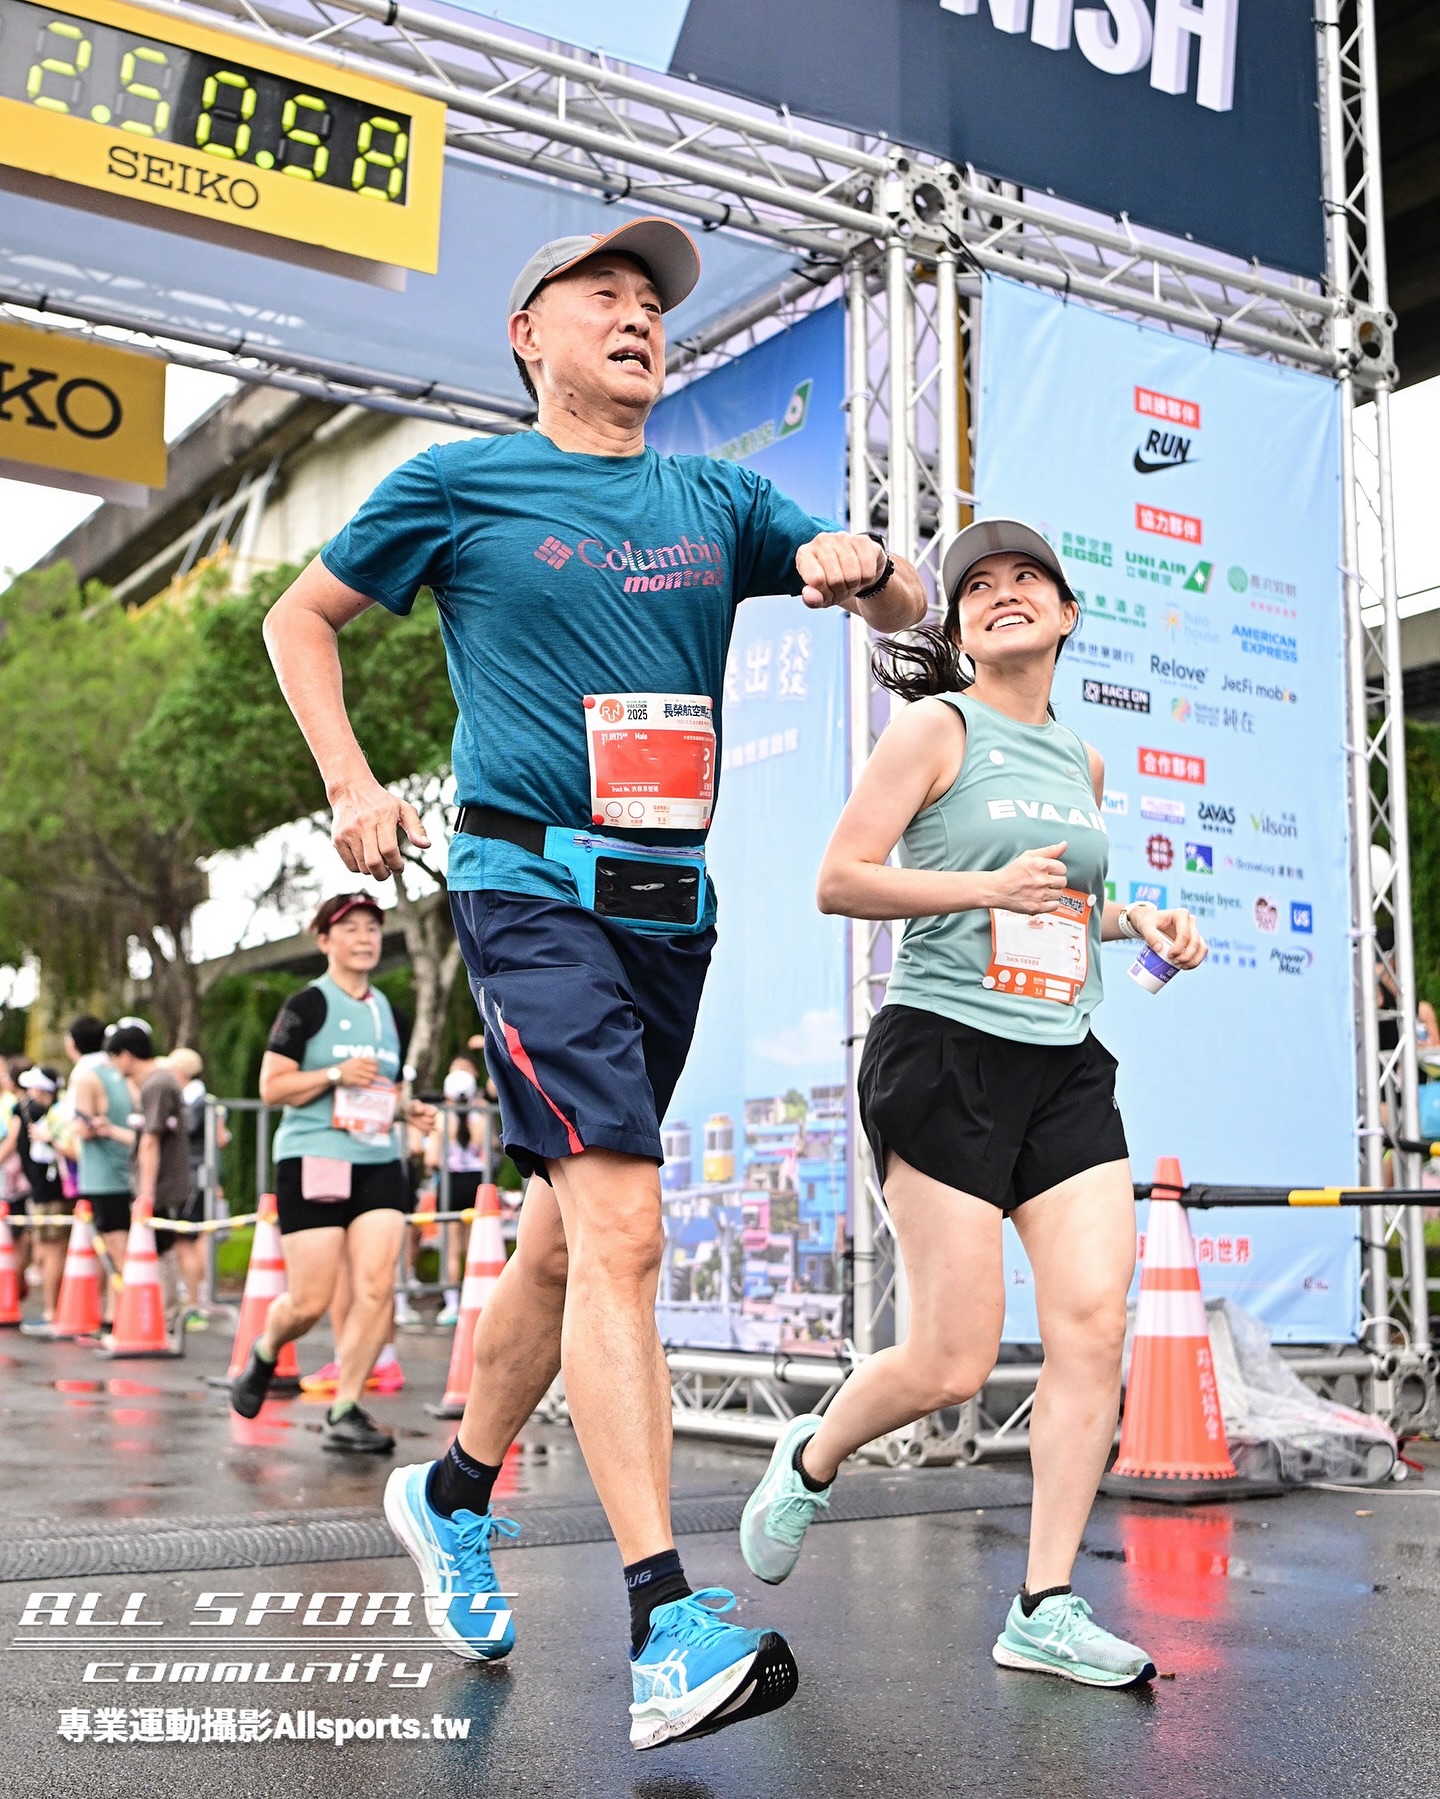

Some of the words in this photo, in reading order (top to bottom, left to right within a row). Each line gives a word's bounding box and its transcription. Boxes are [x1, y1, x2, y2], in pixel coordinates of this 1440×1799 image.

[108, 145, 259, 210] SEIKO
[1145, 429, 1191, 461] RUN
[577, 535, 722, 571] Columbia
[1062, 545, 1112, 567] EGSC
[1159, 559, 1186, 575] AIR
[1231, 624, 1297, 648] AMERICAN
[1241, 640, 1297, 663] EXPRESS
[1150, 654, 1205, 684] Relove
[1102, 684, 1131, 701] RACE
[1131, 691, 1148, 704] ON
[627, 709, 648, 720] 2025
[1143, 752, 1201, 780] 合作夥伴
[987, 800, 1066, 823] EVA
[1293, 909, 1310, 928] US
[1270, 948, 1306, 966] Power
